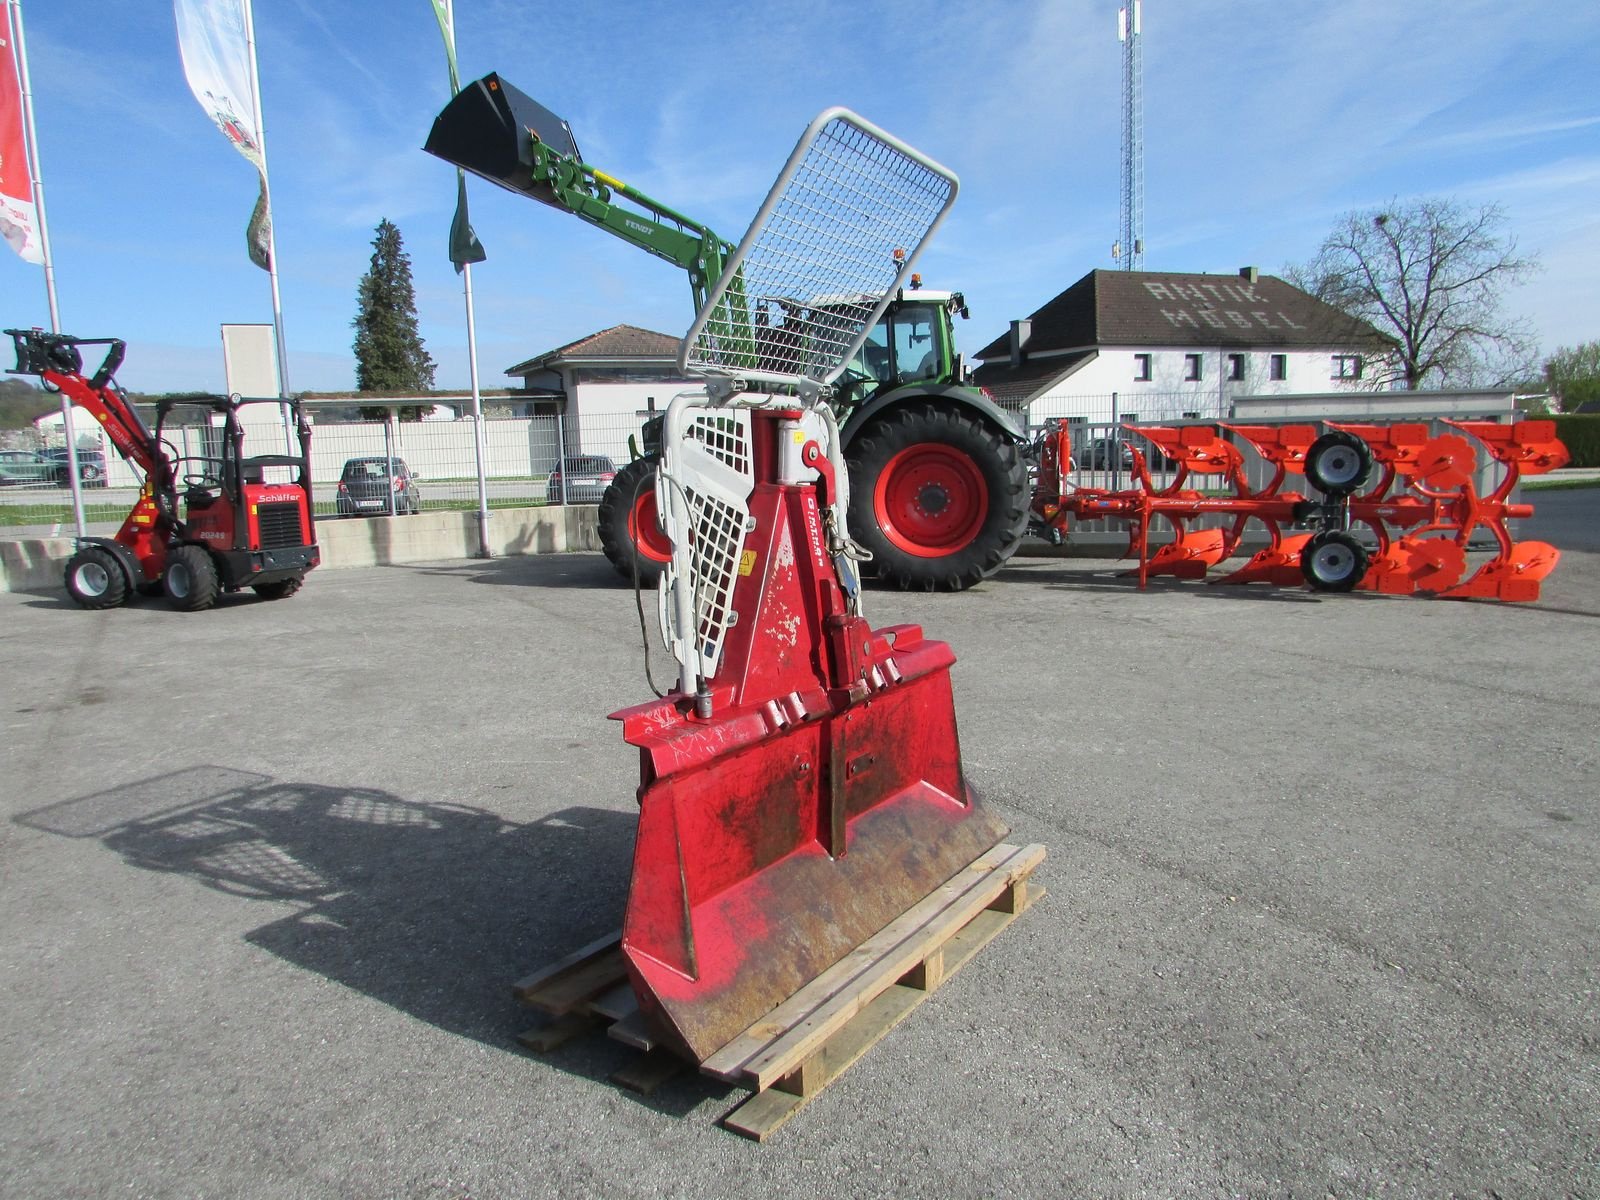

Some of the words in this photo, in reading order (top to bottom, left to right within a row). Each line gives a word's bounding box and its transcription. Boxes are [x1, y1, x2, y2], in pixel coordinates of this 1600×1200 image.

[625, 219, 655, 235] FENDT
[1142, 282, 1270, 303] ANTIK
[257, 493, 300, 503] Schäffer
